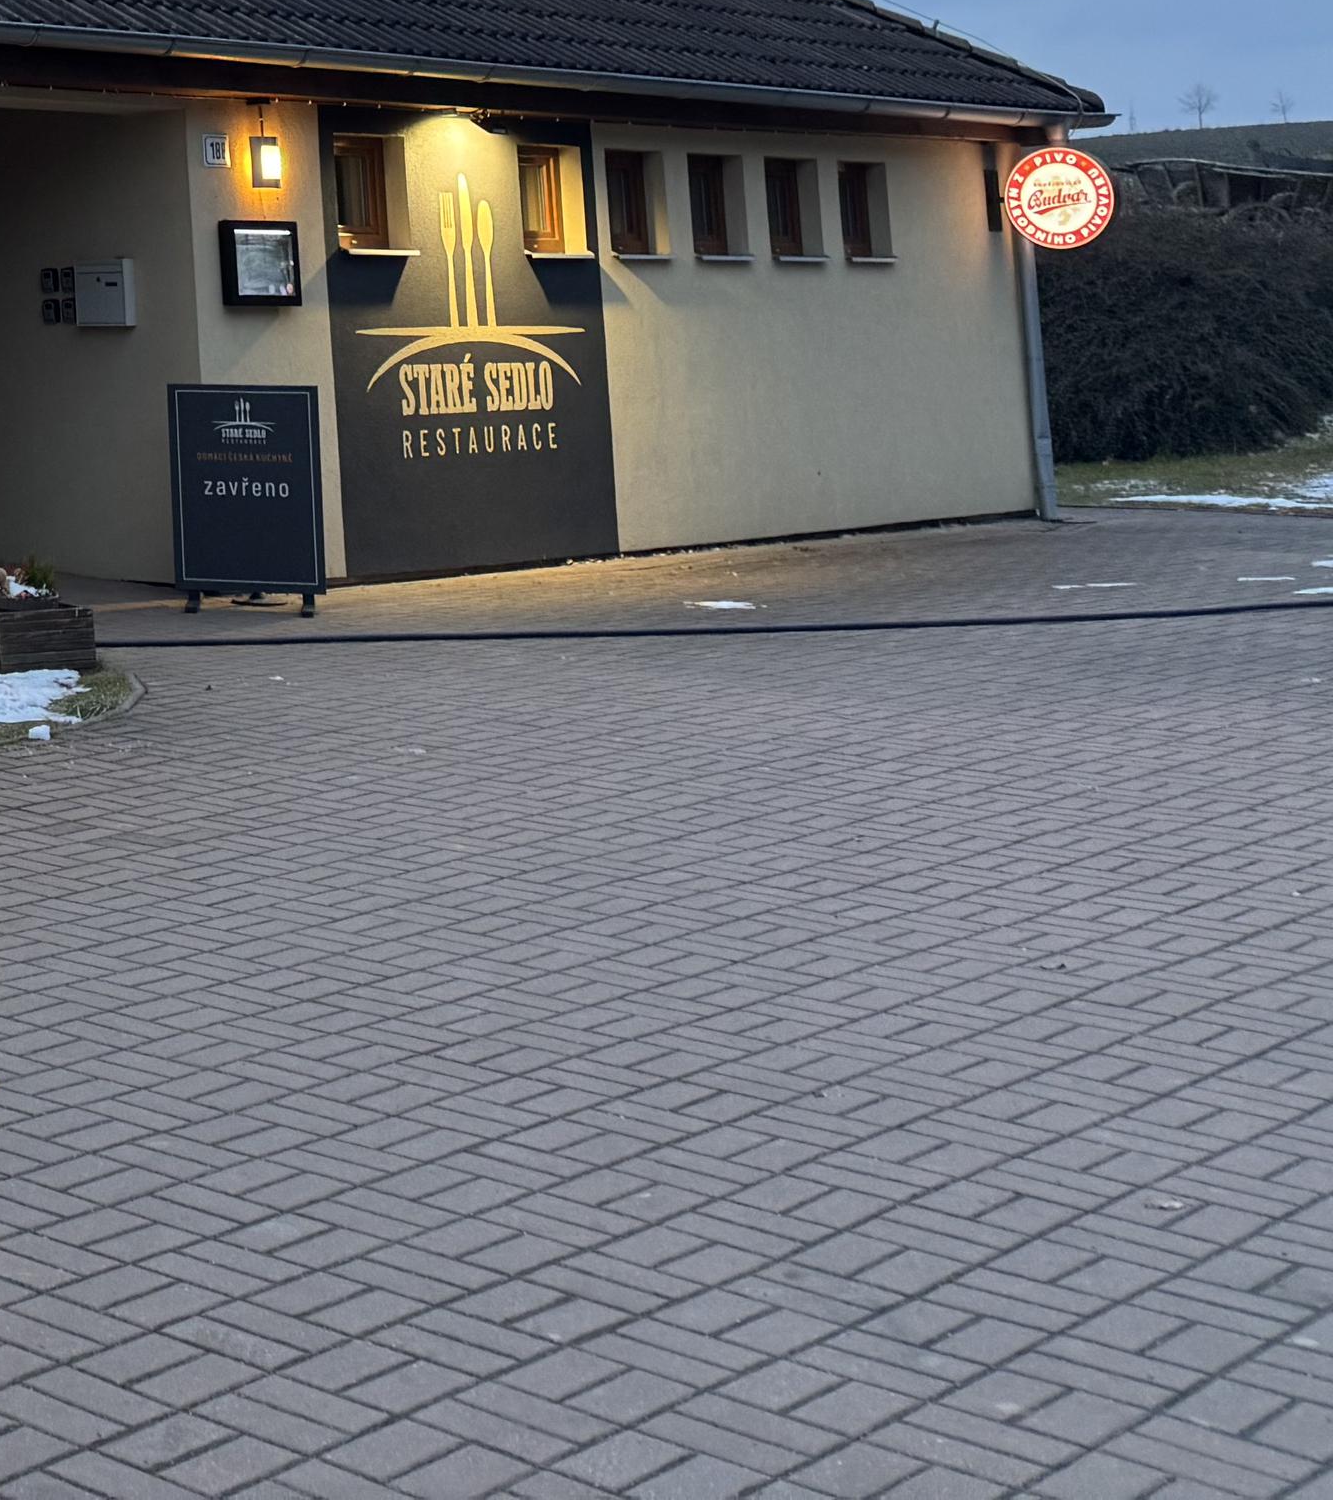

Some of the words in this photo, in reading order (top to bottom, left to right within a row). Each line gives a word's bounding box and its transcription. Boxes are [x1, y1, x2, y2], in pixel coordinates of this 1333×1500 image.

[1033, 152, 1077, 167] PIVO
[1013, 172, 1024, 184] Z
[1080, 168, 1109, 238] PIVOVARU
[1027, 189, 1092, 210] Budvar
[398, 353, 478, 417] STARÉ
[484, 360, 554, 412] SEDLO
[402, 422, 558, 460] RESTAURACE
[204, 477, 290, 498] zavřeno
